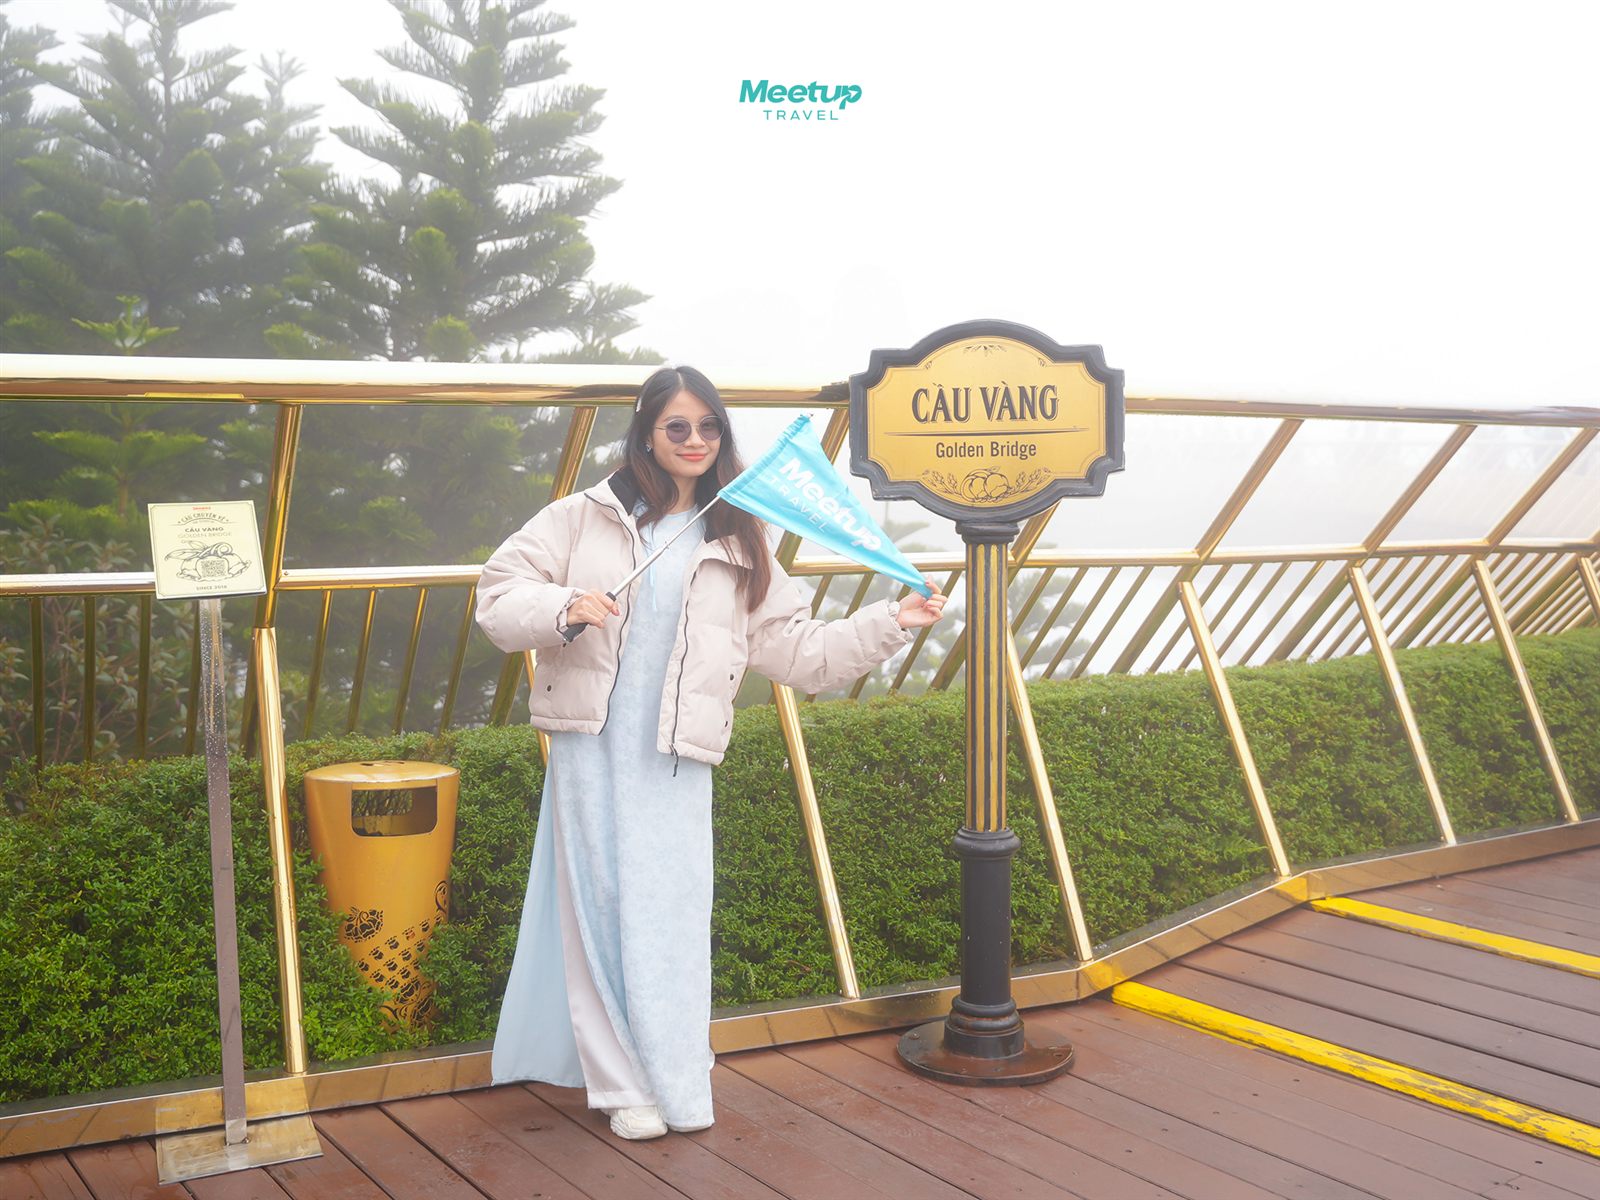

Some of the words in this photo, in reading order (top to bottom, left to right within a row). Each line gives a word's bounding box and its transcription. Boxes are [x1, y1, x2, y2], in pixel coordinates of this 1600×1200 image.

[911, 381, 971, 424] CẦU
[979, 380, 1060, 423] VÀNG
[936, 441, 984, 459] Golden
[990, 440, 1037, 461] Bridge
[770, 475, 826, 534] TRAVEL
[779, 457, 882, 551] Meetup
